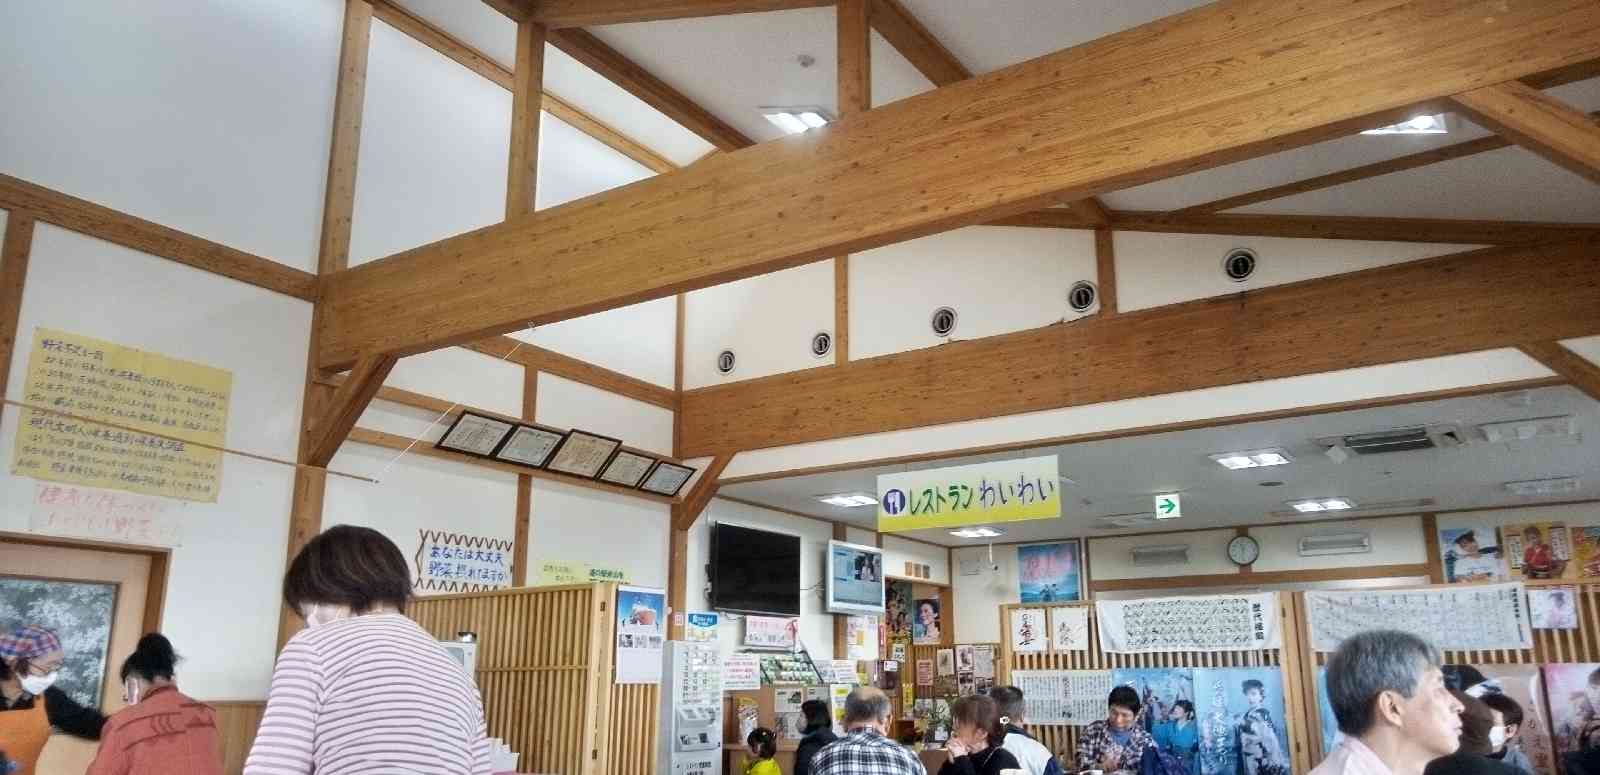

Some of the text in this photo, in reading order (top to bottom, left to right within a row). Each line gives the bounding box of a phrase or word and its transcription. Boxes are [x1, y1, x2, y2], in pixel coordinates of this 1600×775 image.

[909, 474, 1055, 515] レストラン わいわい
[430, 546, 504, 566] あなたは大丈夫
